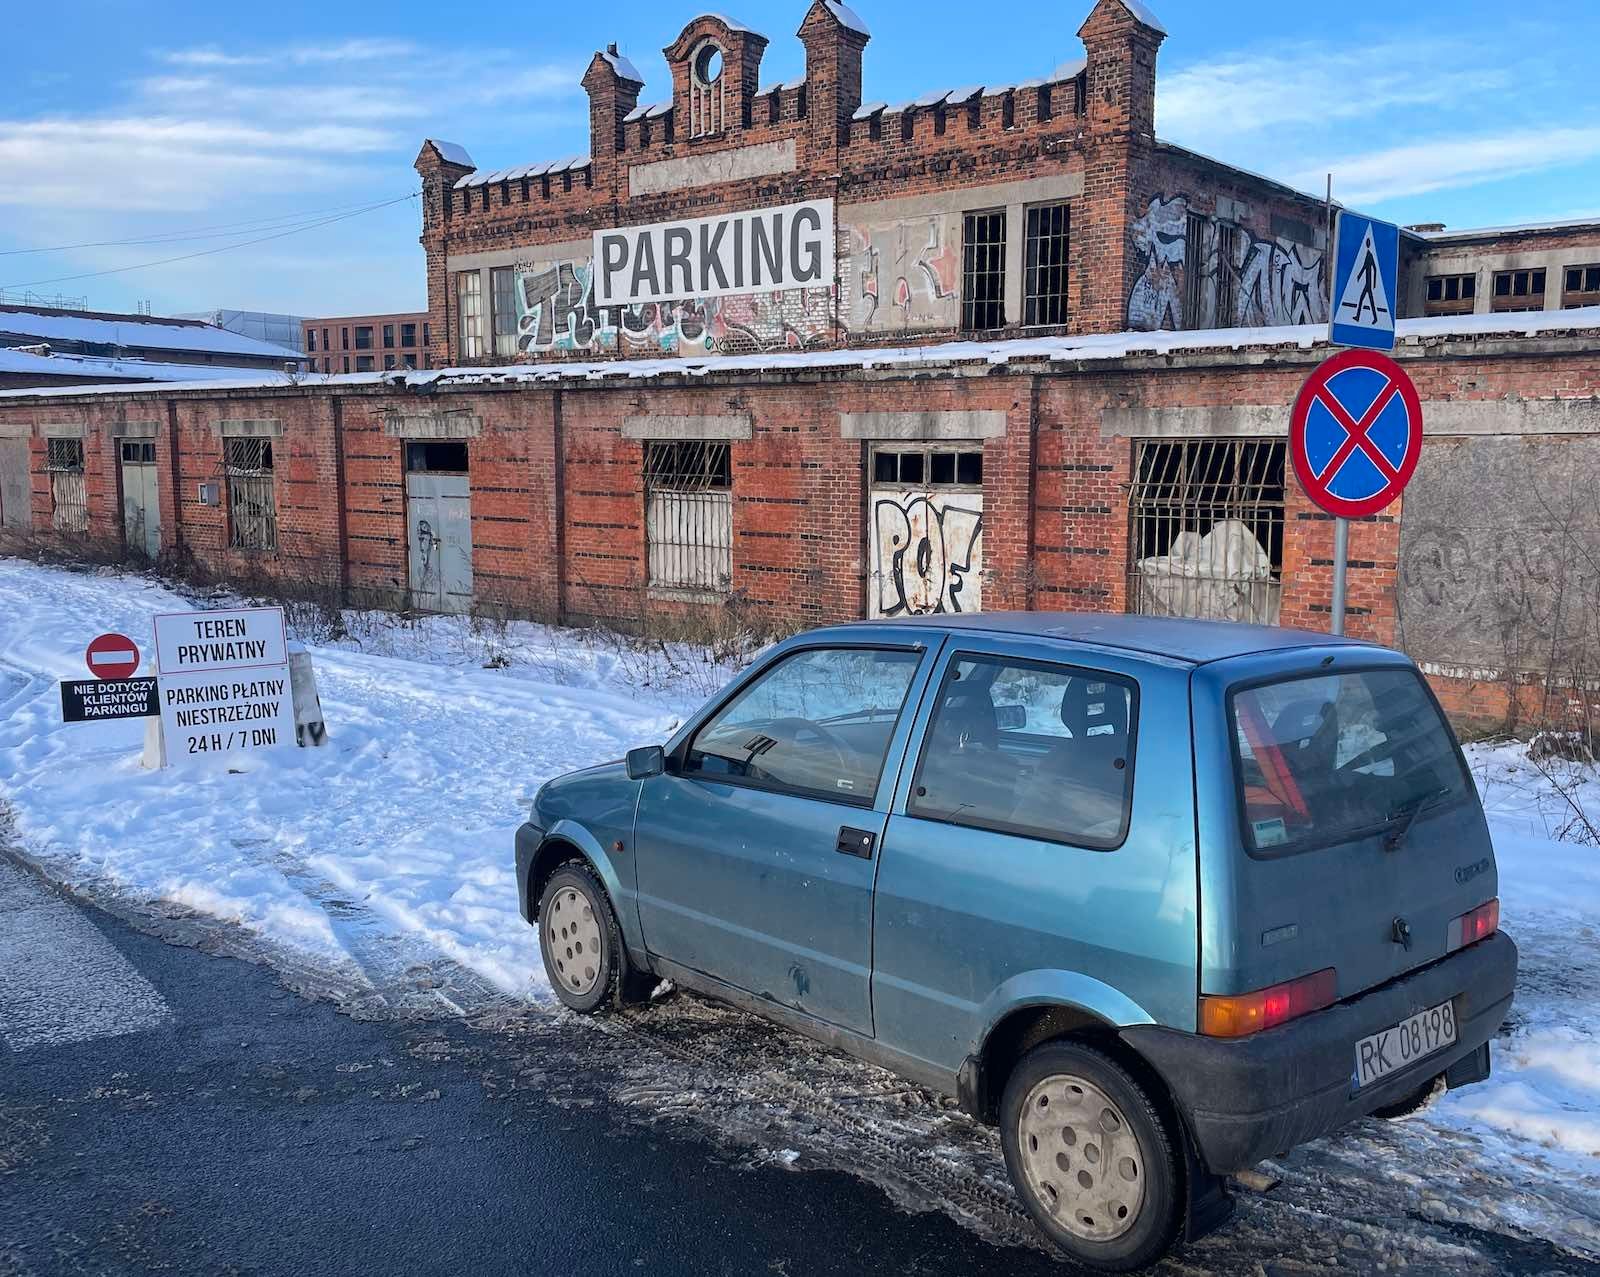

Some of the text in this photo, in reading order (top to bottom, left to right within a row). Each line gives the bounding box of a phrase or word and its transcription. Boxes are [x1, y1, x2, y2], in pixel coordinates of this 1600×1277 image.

[601, 207, 822, 299] PARKING
[194, 618, 246, 639] TEREN
[178, 640, 266, 664] PRYWATNY
[74, 681, 155, 695] NIE DOTYCZY
[83, 691, 148, 706] KLIENTÓW
[167, 679, 284, 705] PARKING PŁATNY
[84, 703, 148, 716] PARKINGU
[176, 701, 280, 727] NIESTRZEŻONY
[188, 735, 209, 754] 24
[212, 734, 222, 751] H
[238, 731, 248, 748] 7
[252, 728, 276, 746] DNI
[1360, 1005, 1453, 1080] RK 08198
